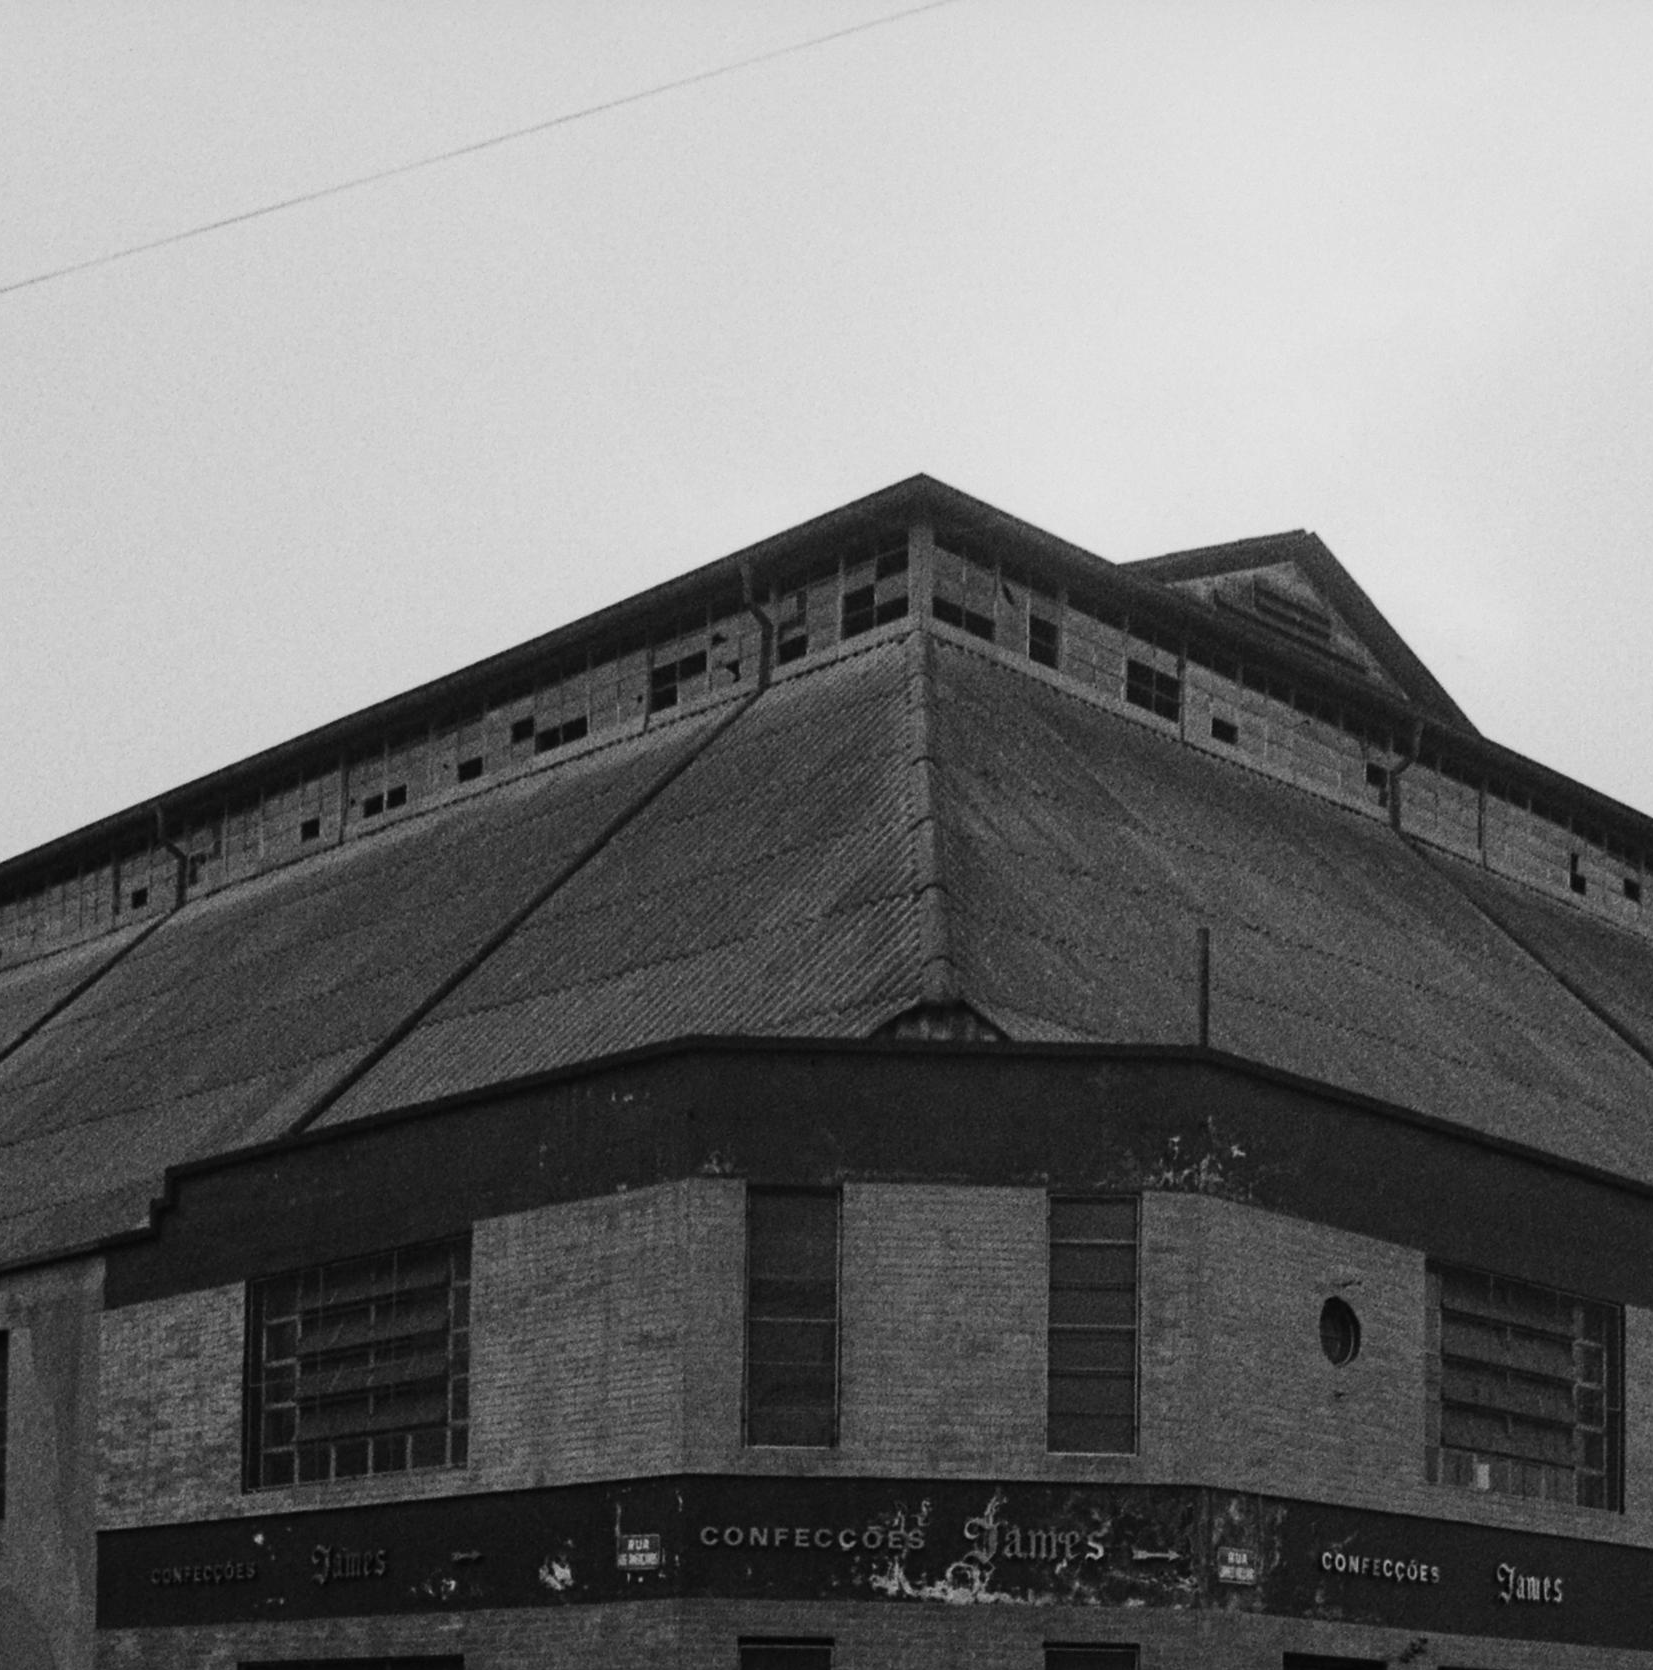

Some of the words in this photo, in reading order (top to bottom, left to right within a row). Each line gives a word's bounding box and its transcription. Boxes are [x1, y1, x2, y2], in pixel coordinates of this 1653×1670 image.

[627, 1538, 650, 1551] RUA
[963, 1515, 1105, 1565] James
[310, 1543, 387, 1586] James
[1496, 1562, 1564, 1604] James
